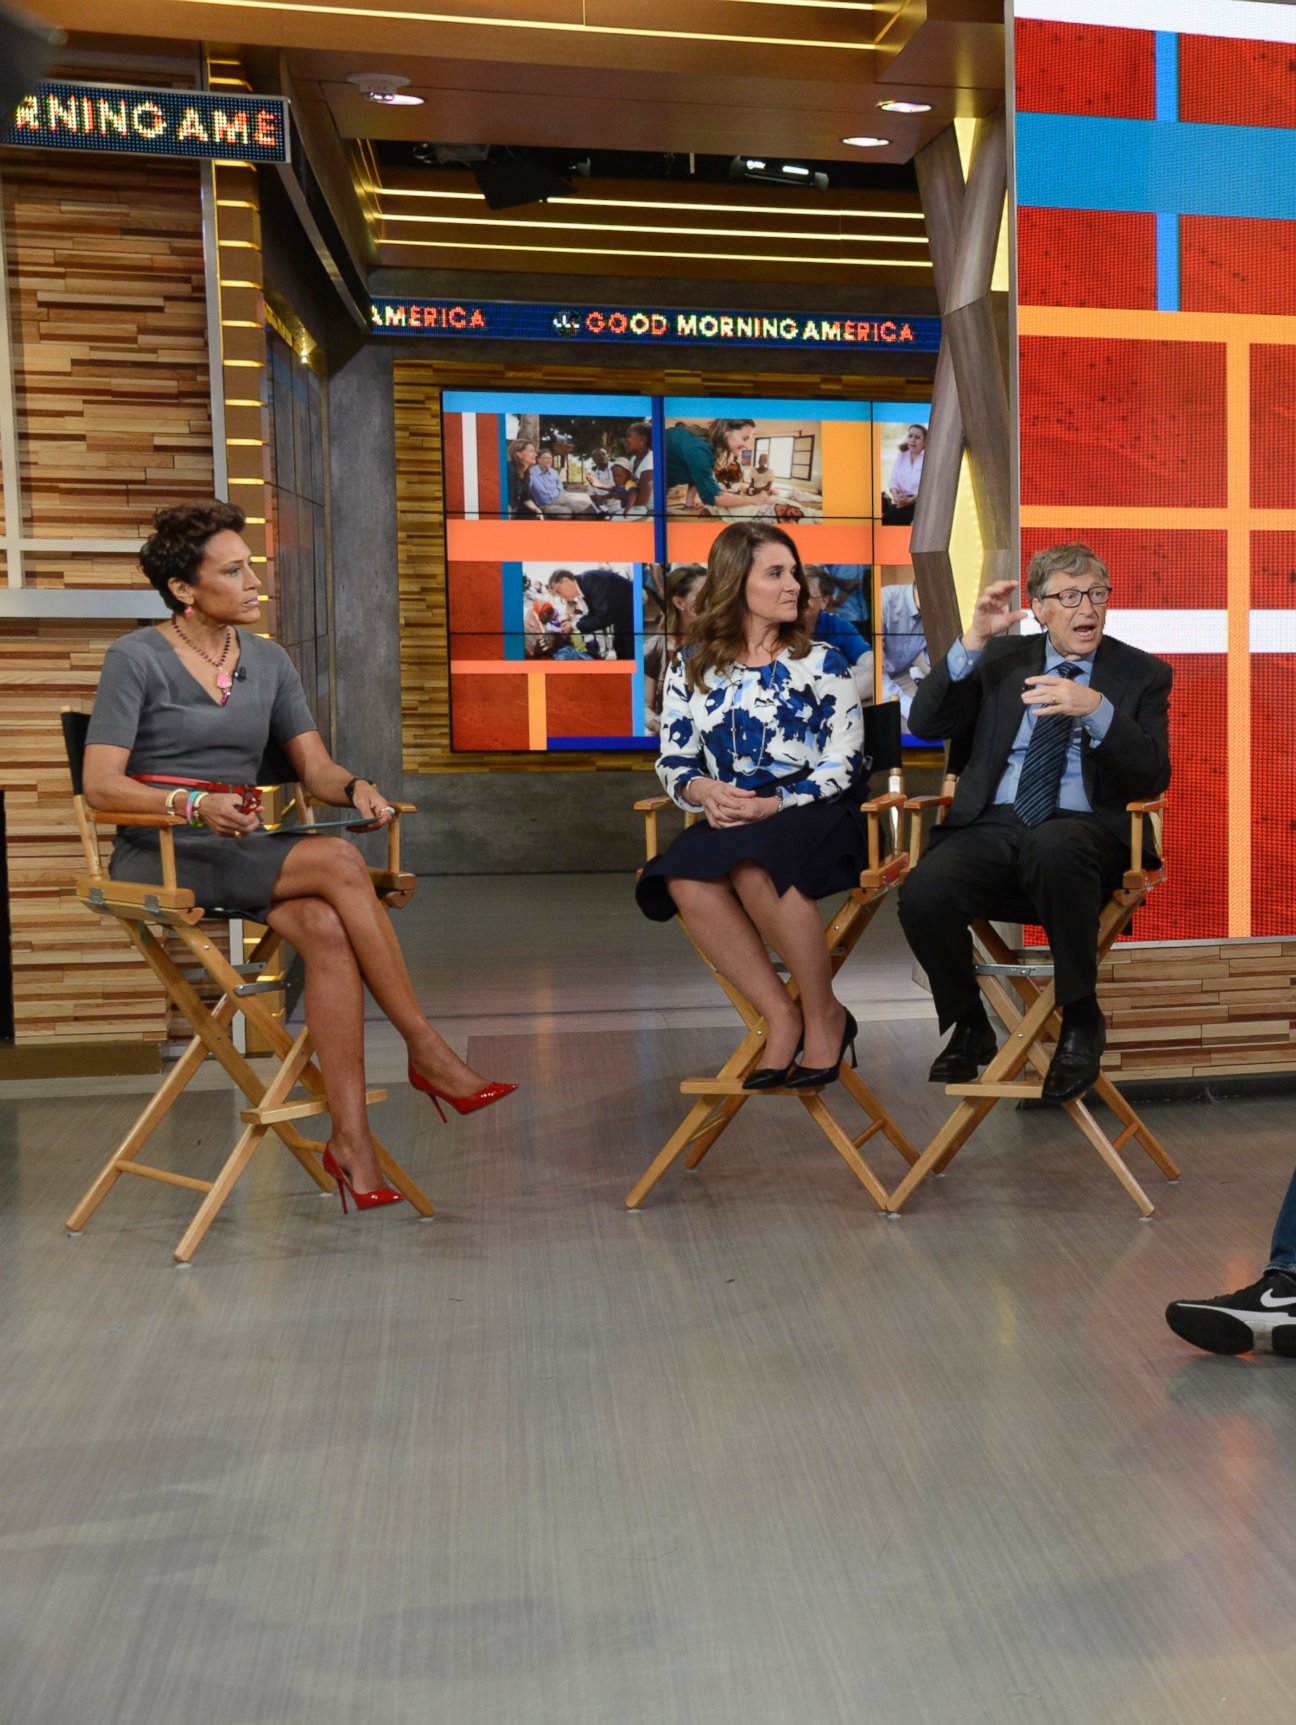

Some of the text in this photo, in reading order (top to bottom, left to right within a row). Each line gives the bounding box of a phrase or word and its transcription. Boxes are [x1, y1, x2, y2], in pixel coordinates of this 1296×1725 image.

[178, 107, 276, 146] AME
[586, 311, 668, 336] GOOD
[677, 314, 798, 340] MORNING
[803, 320, 914, 342] AMERICA
